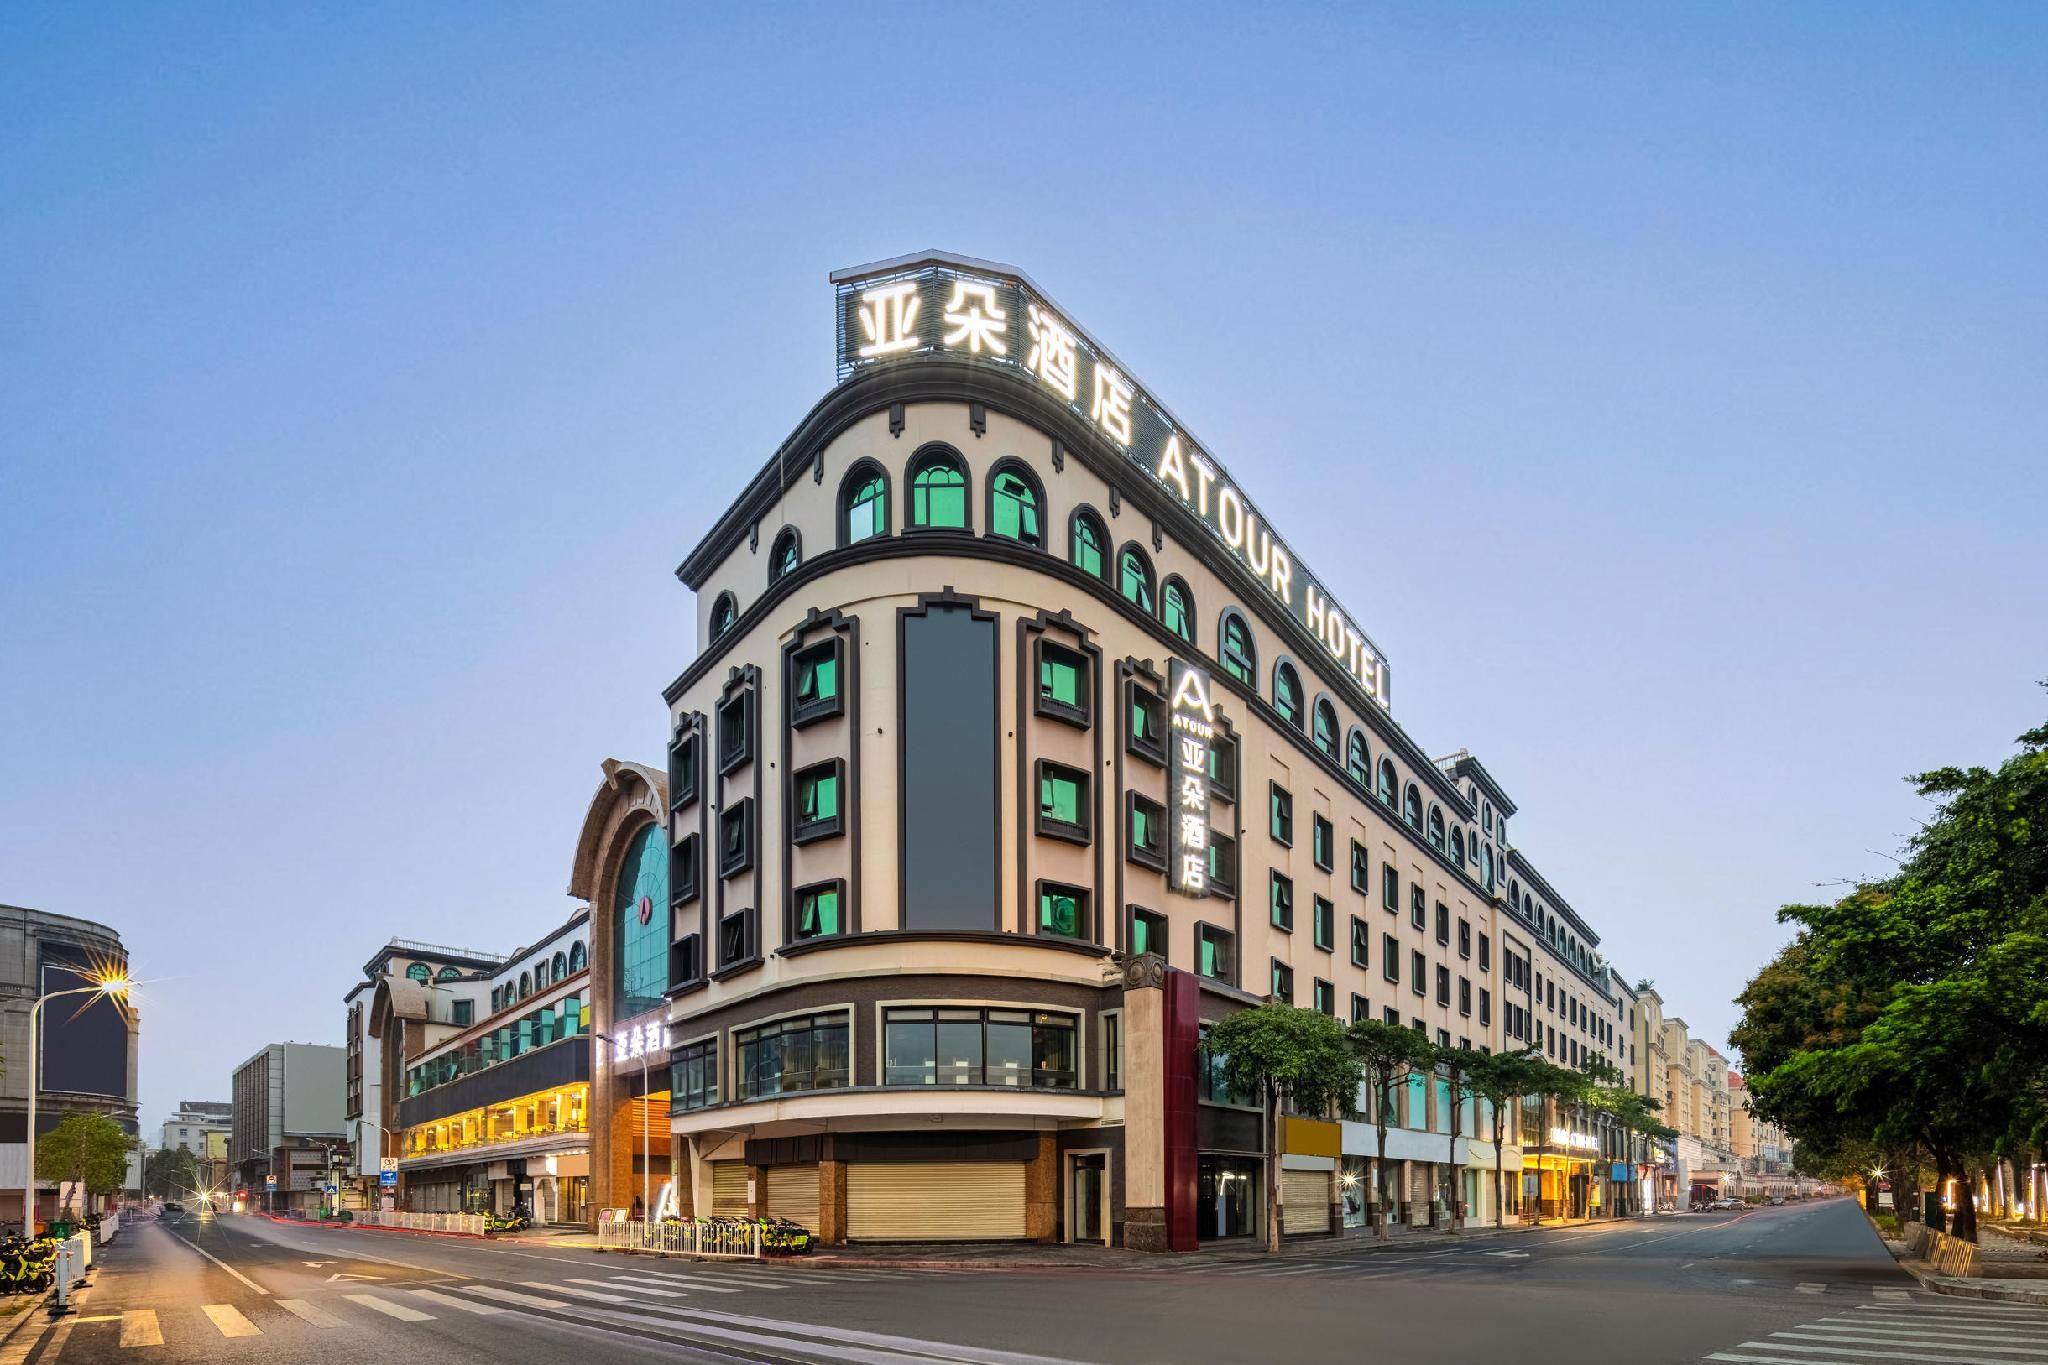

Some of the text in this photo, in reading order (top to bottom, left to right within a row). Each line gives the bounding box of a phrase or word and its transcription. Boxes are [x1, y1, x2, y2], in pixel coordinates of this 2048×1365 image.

[858, 279, 1388, 708] 亚朵酒店 ATOUR HOTEL
[1173, 714, 1213, 738] ATOUR
[1182, 737, 1205, 888] 亚朵酒店
